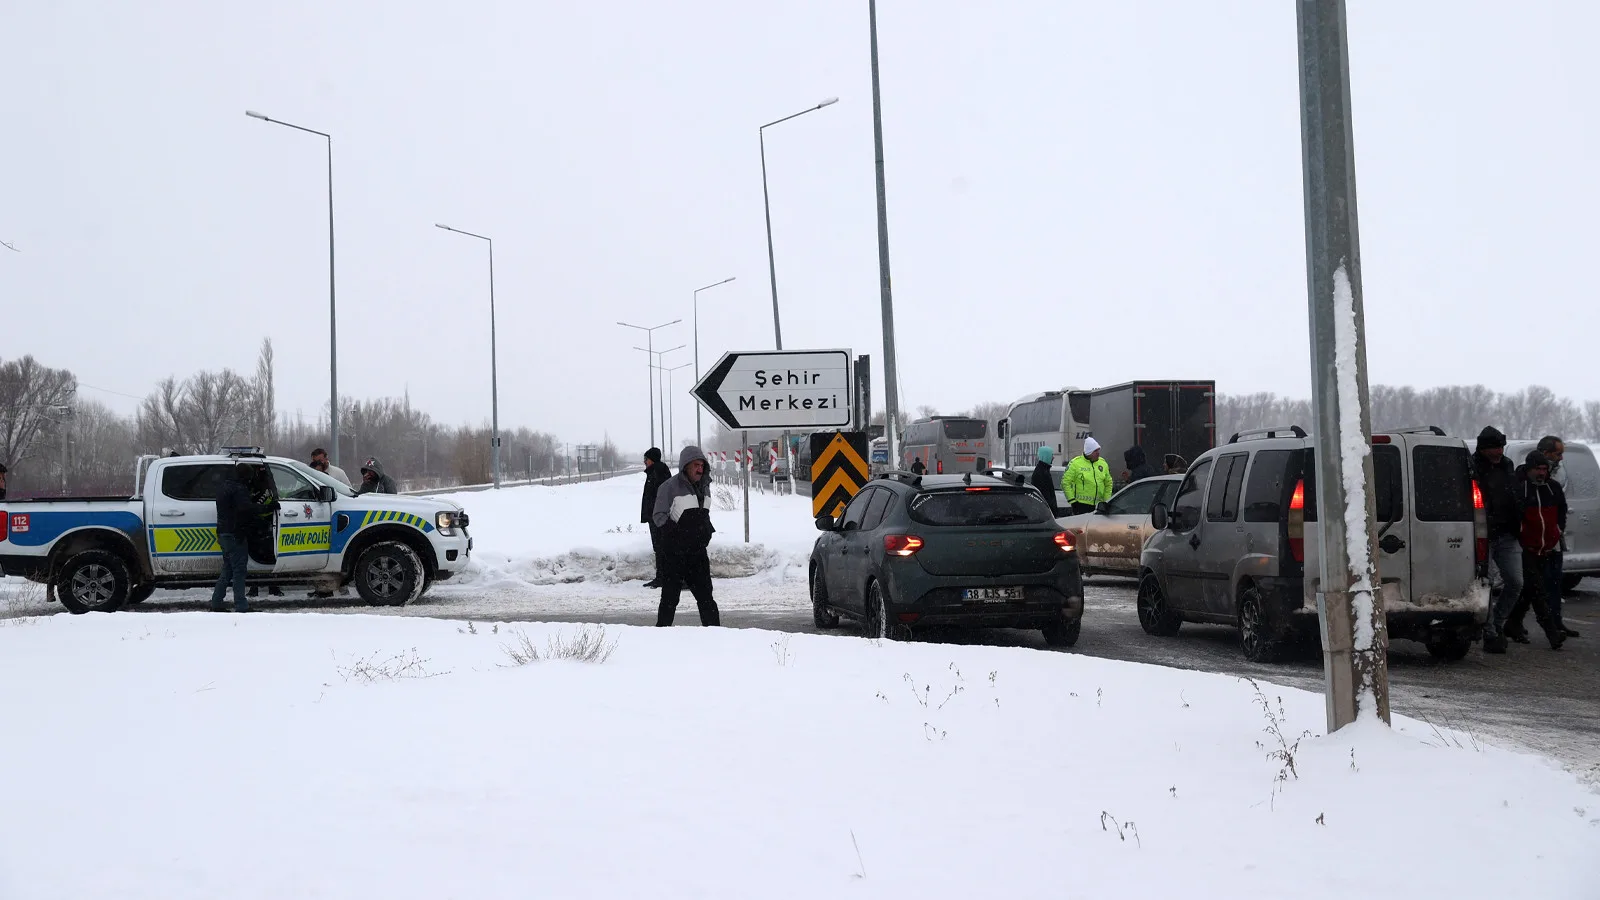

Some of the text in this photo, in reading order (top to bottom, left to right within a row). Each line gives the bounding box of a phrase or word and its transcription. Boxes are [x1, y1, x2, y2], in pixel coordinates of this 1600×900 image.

[755, 370, 820, 388] Şehir
[739, 394, 836, 411] Merkezi
[13, 516, 27, 526] 112
[281, 530, 306, 546] TRAFİK
[967, 589, 980, 600] 38
